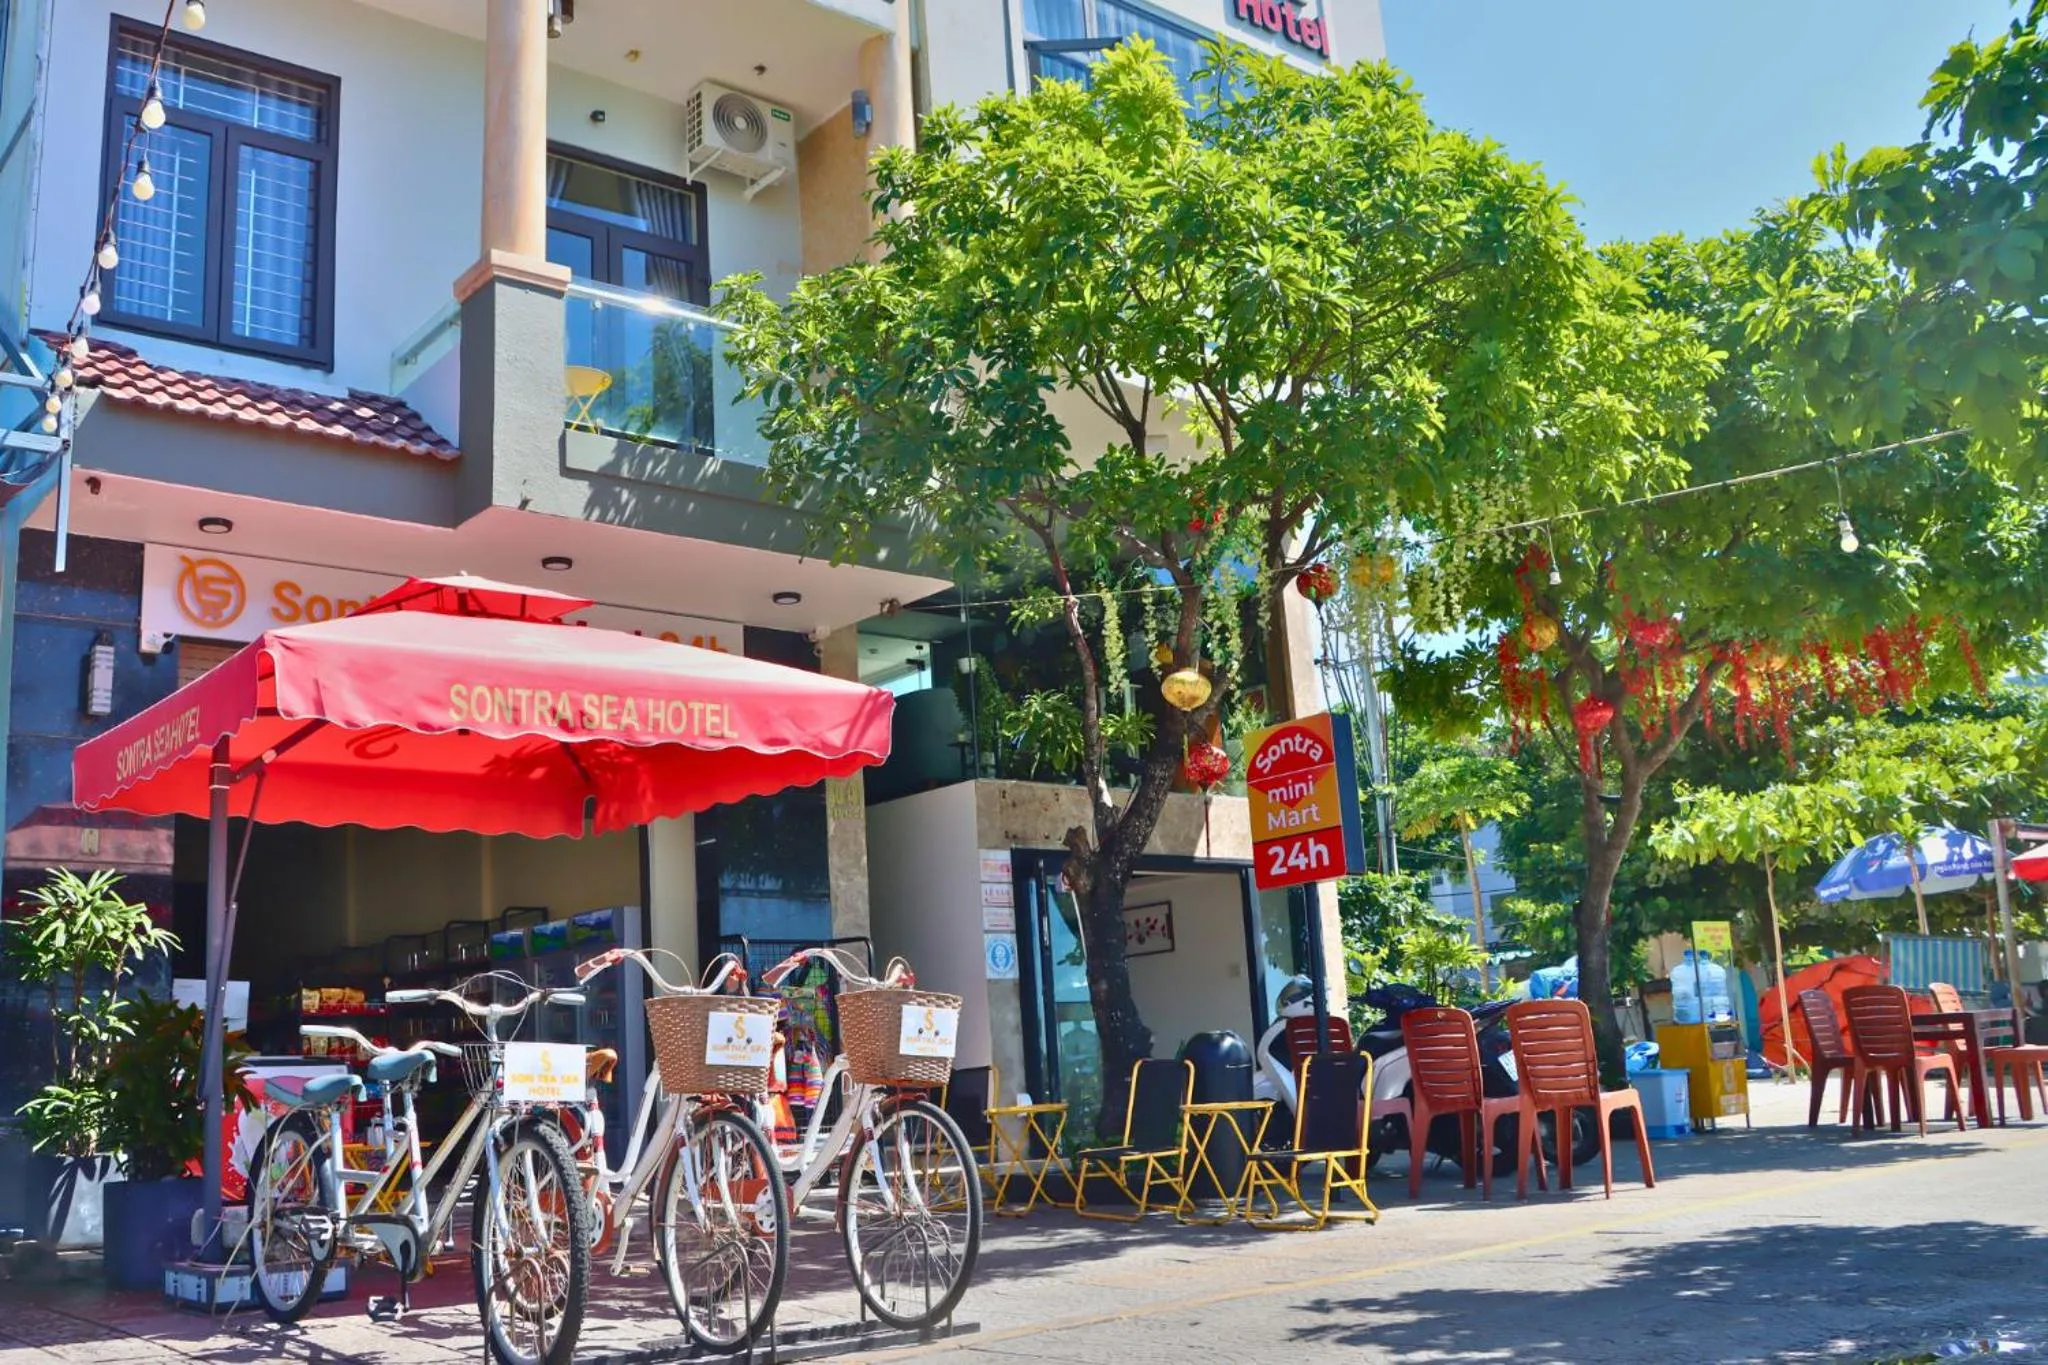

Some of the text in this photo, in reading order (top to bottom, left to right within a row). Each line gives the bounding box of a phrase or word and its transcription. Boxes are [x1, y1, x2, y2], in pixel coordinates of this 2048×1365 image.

[449, 683, 739, 738] SONTRA SEA HOTEL
[116, 704, 201, 782] SONTRA SEA HOTEL
[1255, 732, 1324, 774] Sontra
[1267, 775, 1315, 804] mini
[1267, 803, 1321, 831] Mart
[1268, 837, 1330, 876] 24h
